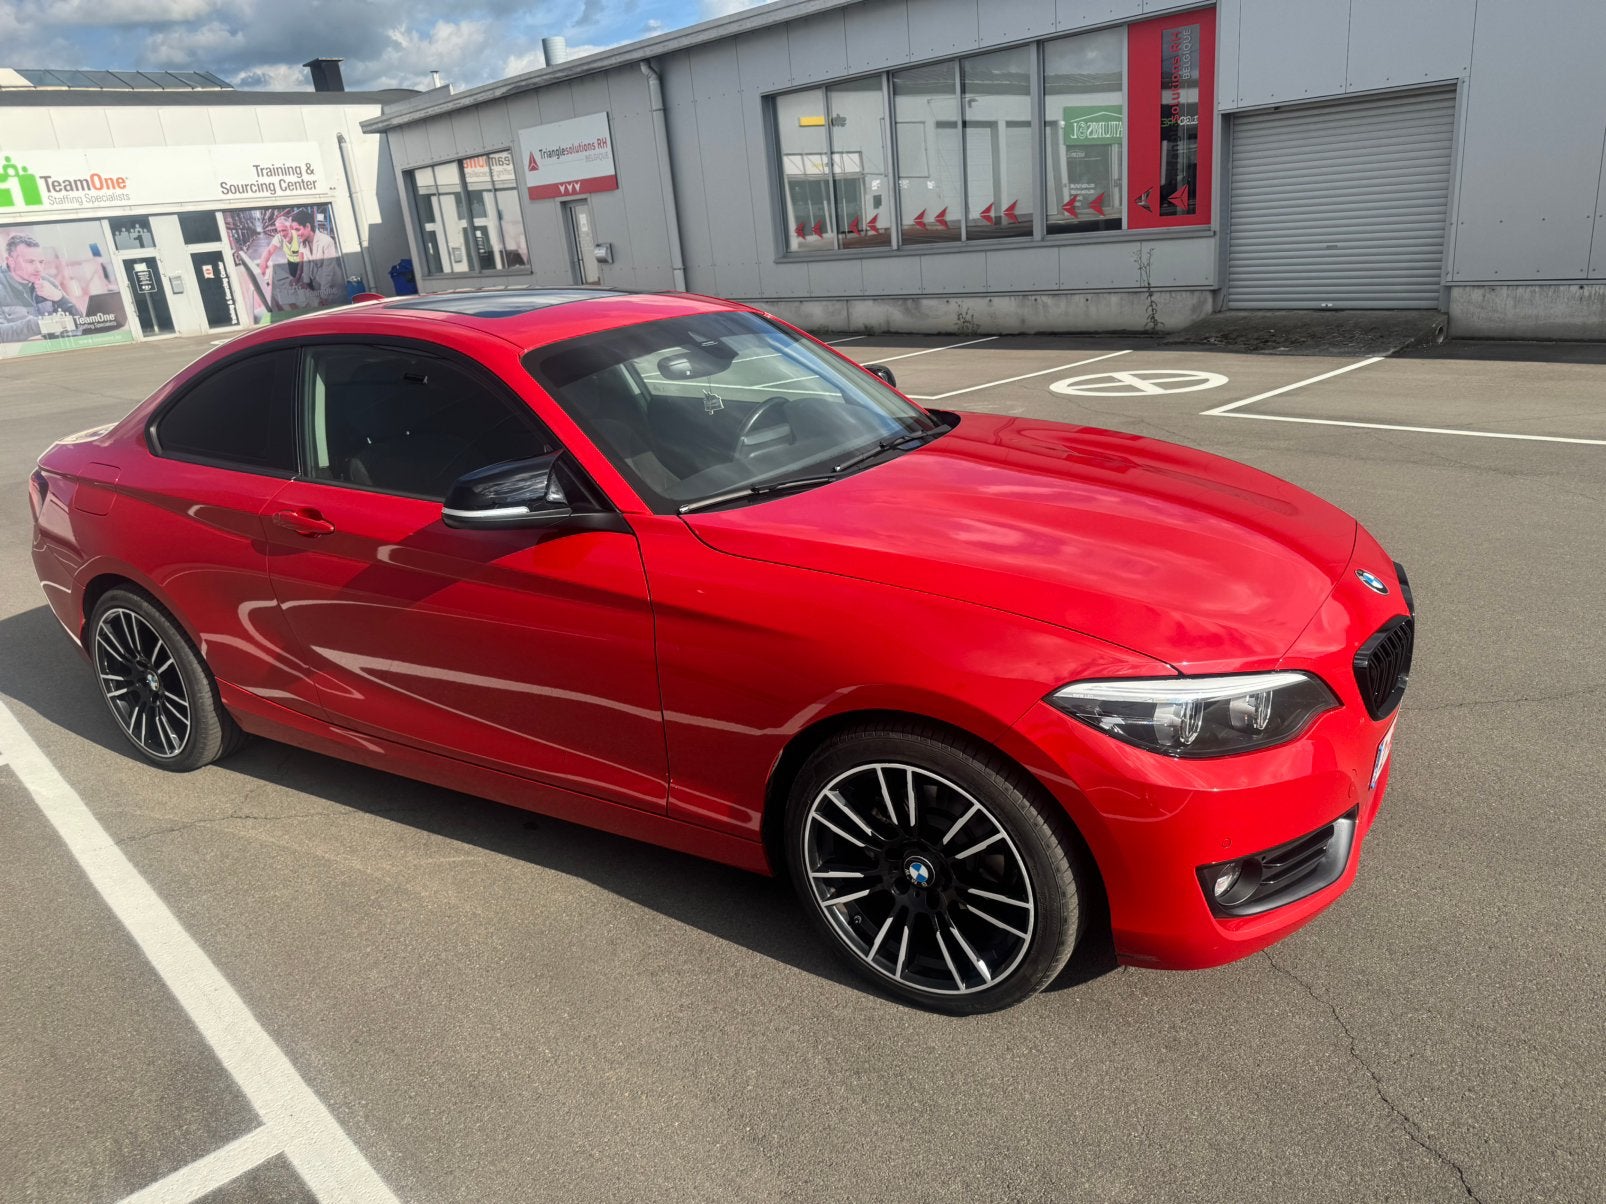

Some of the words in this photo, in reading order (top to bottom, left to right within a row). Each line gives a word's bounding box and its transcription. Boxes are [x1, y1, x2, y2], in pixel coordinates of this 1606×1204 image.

[1183, 27, 1191, 80] BELGIQUE
[539, 141, 596, 160] Trianglesolutions
[596, 137, 608, 150] RH
[252, 163, 303, 179] Training
[305, 162, 315, 176] &
[39, 172, 127, 194] TeamOne
[219, 180, 277, 196] Sourcing
[278, 178, 318, 192] Center
[47, 194, 84, 206] Staffing
[84, 192, 131, 204] Specialists
[73, 312, 116, 325] TeamOne
